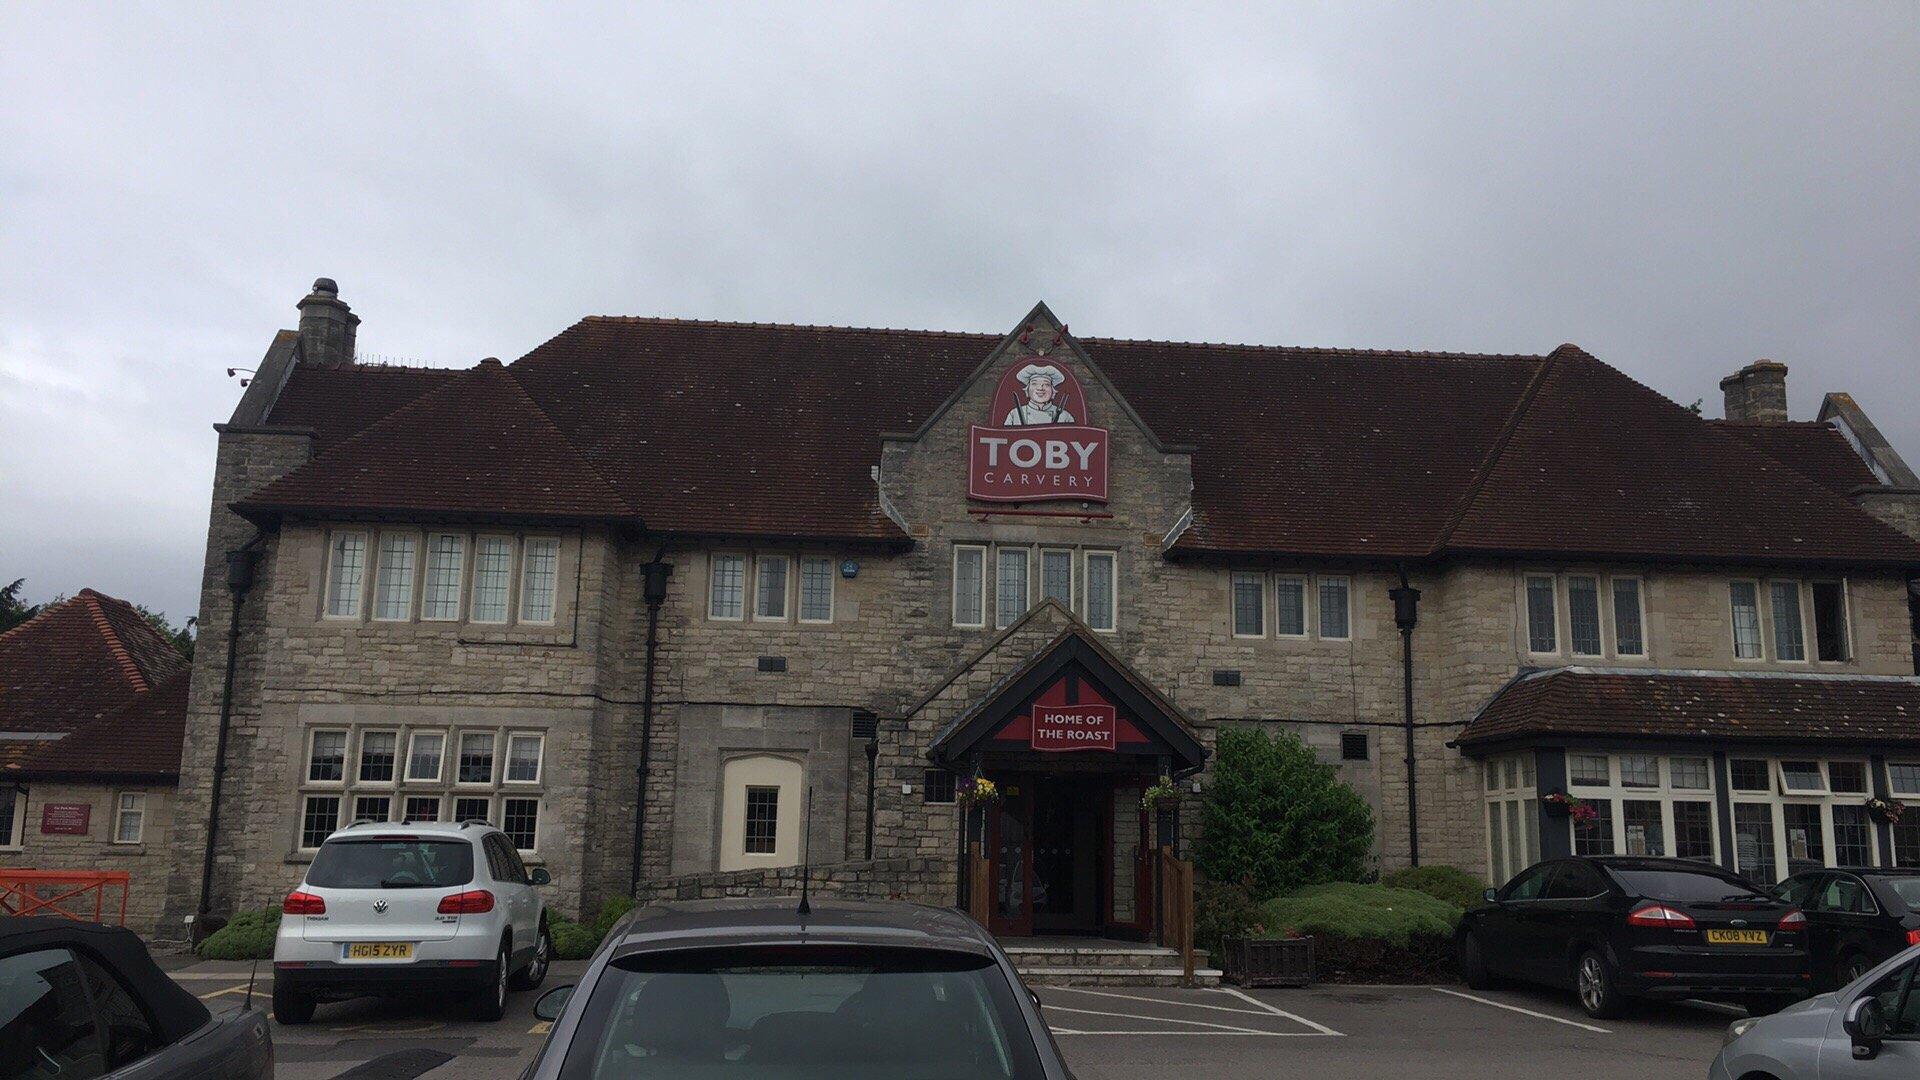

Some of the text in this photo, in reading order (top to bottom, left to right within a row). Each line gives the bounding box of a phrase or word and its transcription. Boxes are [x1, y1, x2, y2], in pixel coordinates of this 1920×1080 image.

[979, 437, 1099, 471] TOBY
[984, 472, 1093, 488] CARVERY
[1044, 713, 1104, 725] HOME OF
[1037, 728, 1110, 741] THE ROAST
[1711, 930, 1740, 941] CK08
[1743, 931, 1764, 942] YVZ
[352, 944, 407, 957] HG15 ZYR
